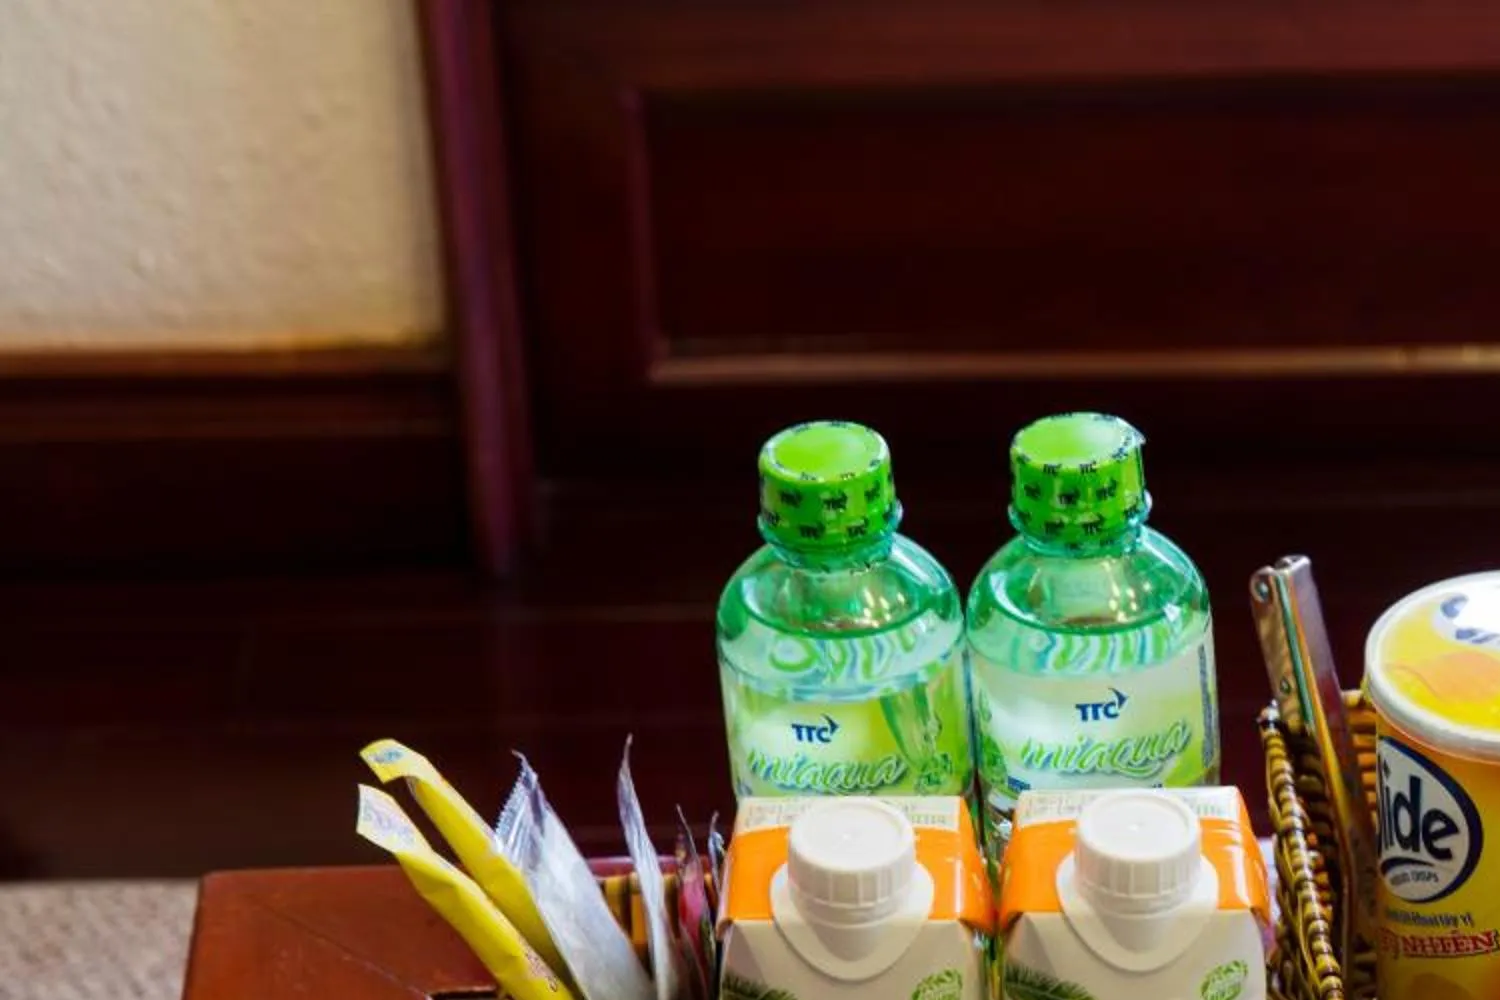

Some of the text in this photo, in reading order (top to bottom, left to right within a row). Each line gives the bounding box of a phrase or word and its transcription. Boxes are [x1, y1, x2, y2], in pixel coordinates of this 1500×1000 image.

[1075, 694, 1127, 722] TTC
[792, 717, 838, 743] TTC
[1379, 750, 1460, 861] lide
